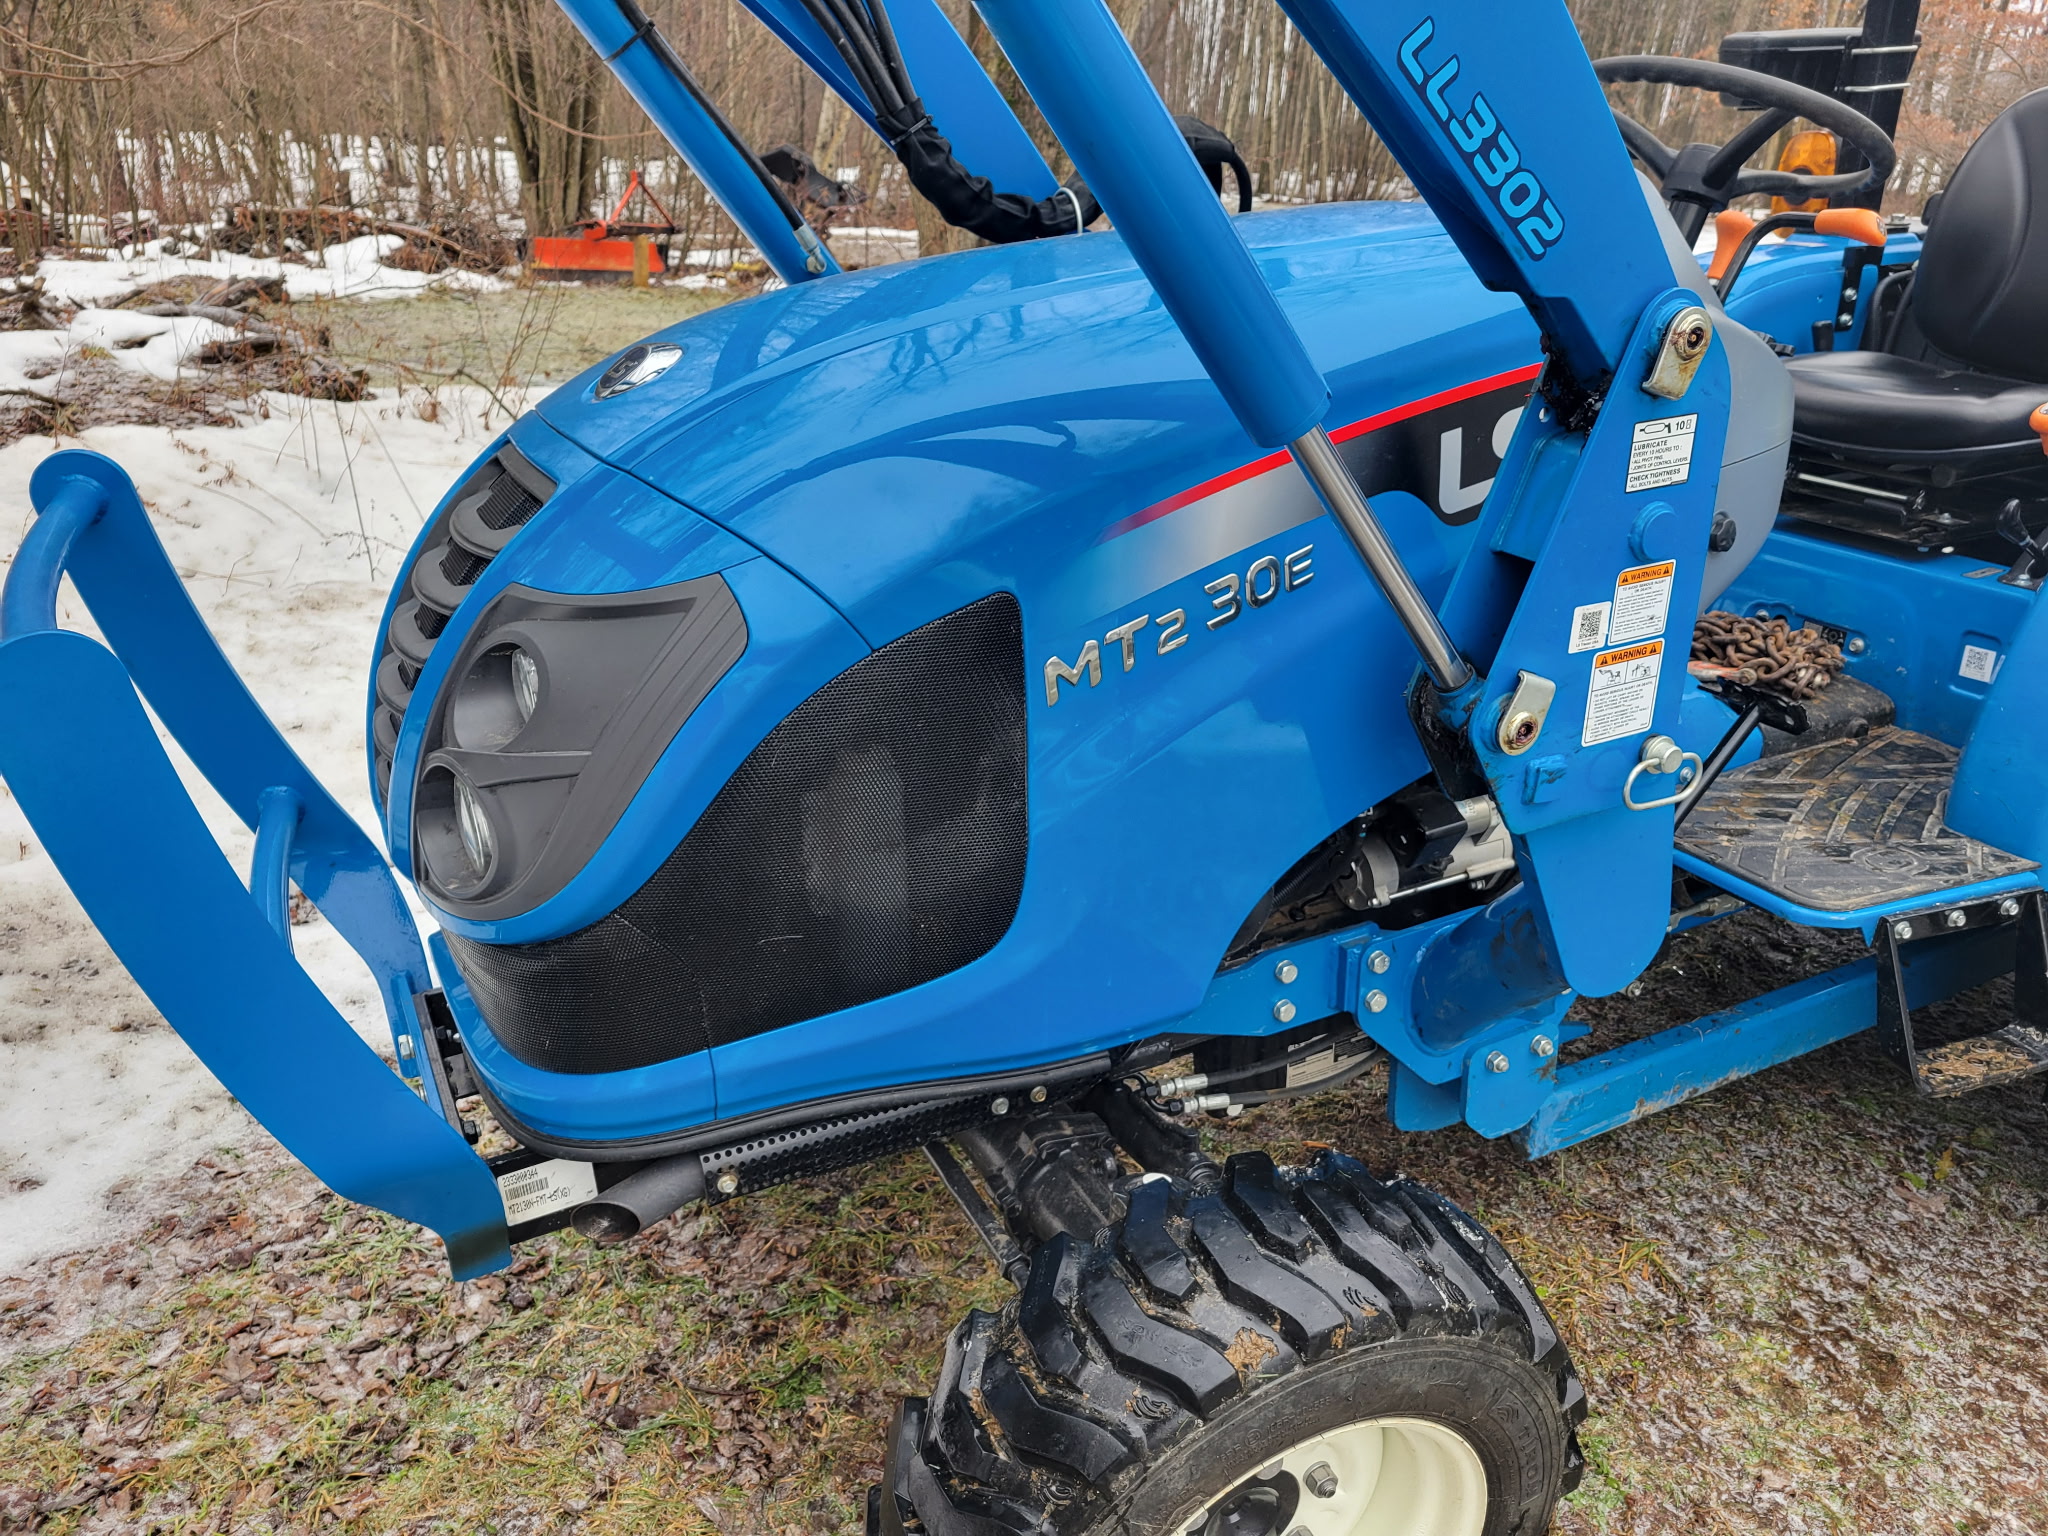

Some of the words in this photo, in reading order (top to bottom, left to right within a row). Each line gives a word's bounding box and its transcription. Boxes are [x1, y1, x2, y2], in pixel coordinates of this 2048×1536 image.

[1399, 17, 1565, 258] LL3302
[1675, 420, 1685, 431] 10
[1634, 440, 1668, 451] LUBRICATE
[1633, 450, 1648, 458] EVERY
[1655, 446, 1673, 455] HOURS
[1653, 459, 1672, 467] CONTROL
[1629, 474, 1648, 483] CHECK
[1649, 468, 1681, 479] TIGHTNESS
[1630, 568, 1662, 581] WARNING
[1610, 646, 1648, 662] WARNING
